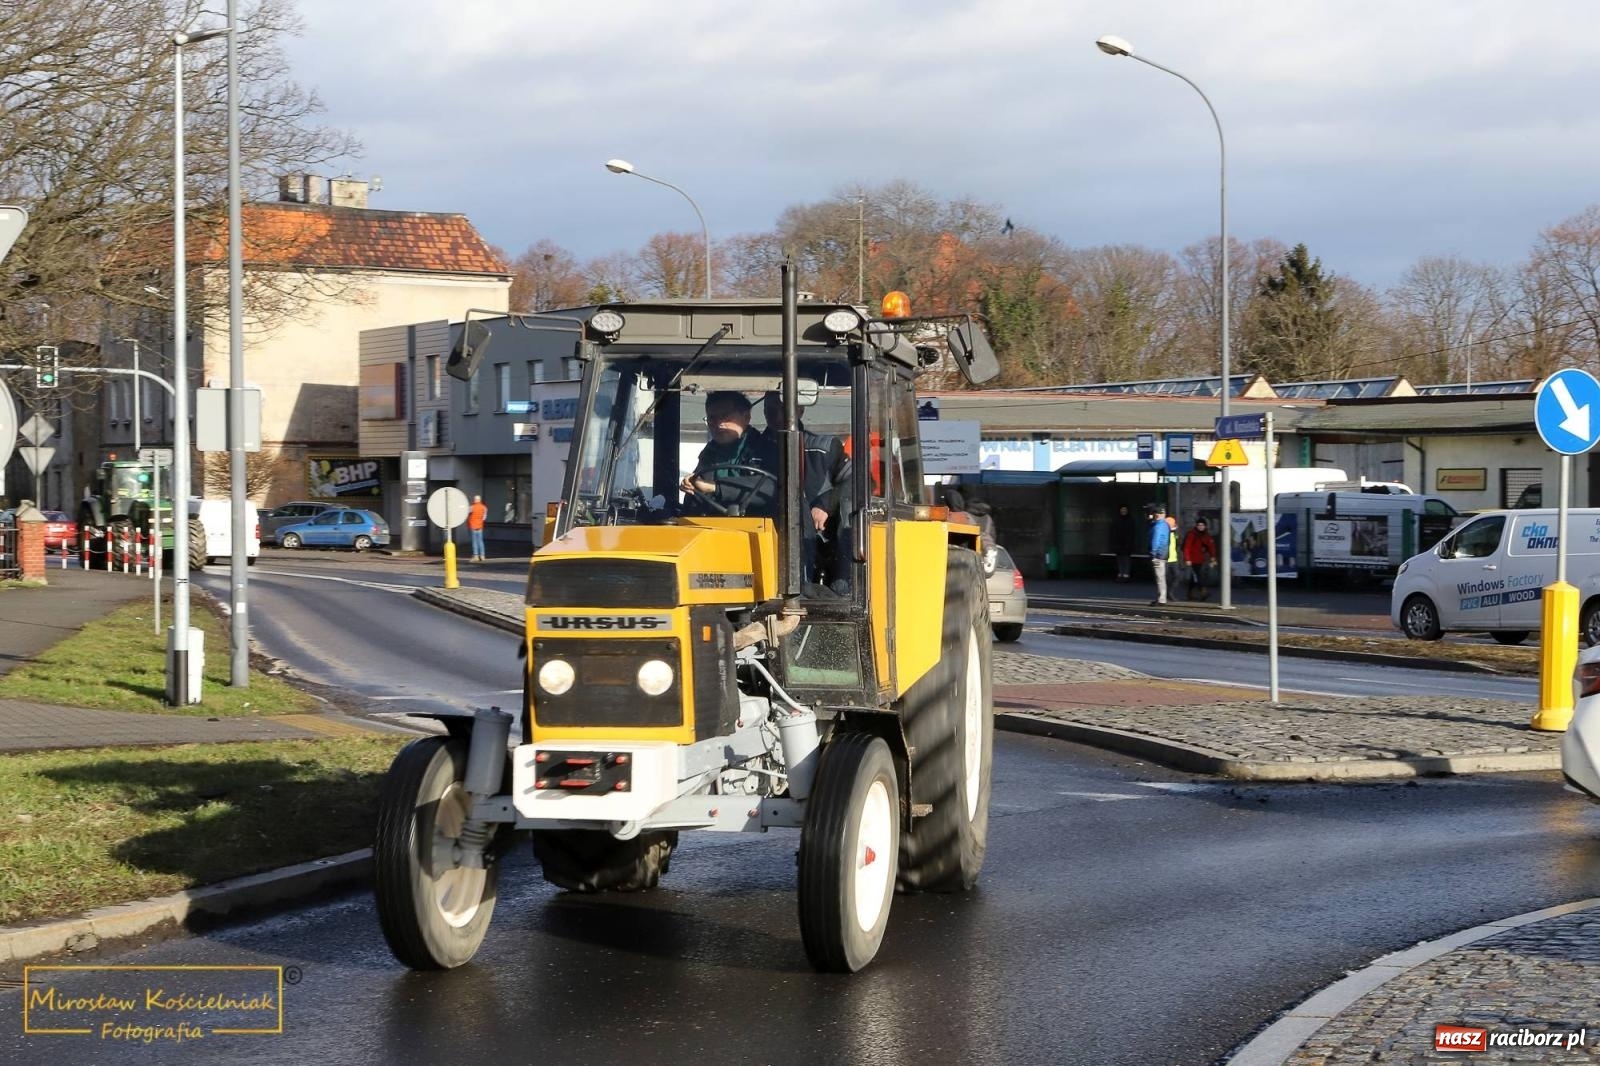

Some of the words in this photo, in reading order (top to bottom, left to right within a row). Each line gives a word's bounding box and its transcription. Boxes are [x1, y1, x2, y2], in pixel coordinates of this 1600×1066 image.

[334, 461, 378, 484] BHP
[1457, 580, 1505, 595] Windows
[1508, 573, 1544, 588] Factory
[1462, 599, 1479, 610] PVC
[1482, 595, 1499, 606] ALU
[1508, 590, 1535, 602] WOOD
[549, 616, 661, 630] URSUS
